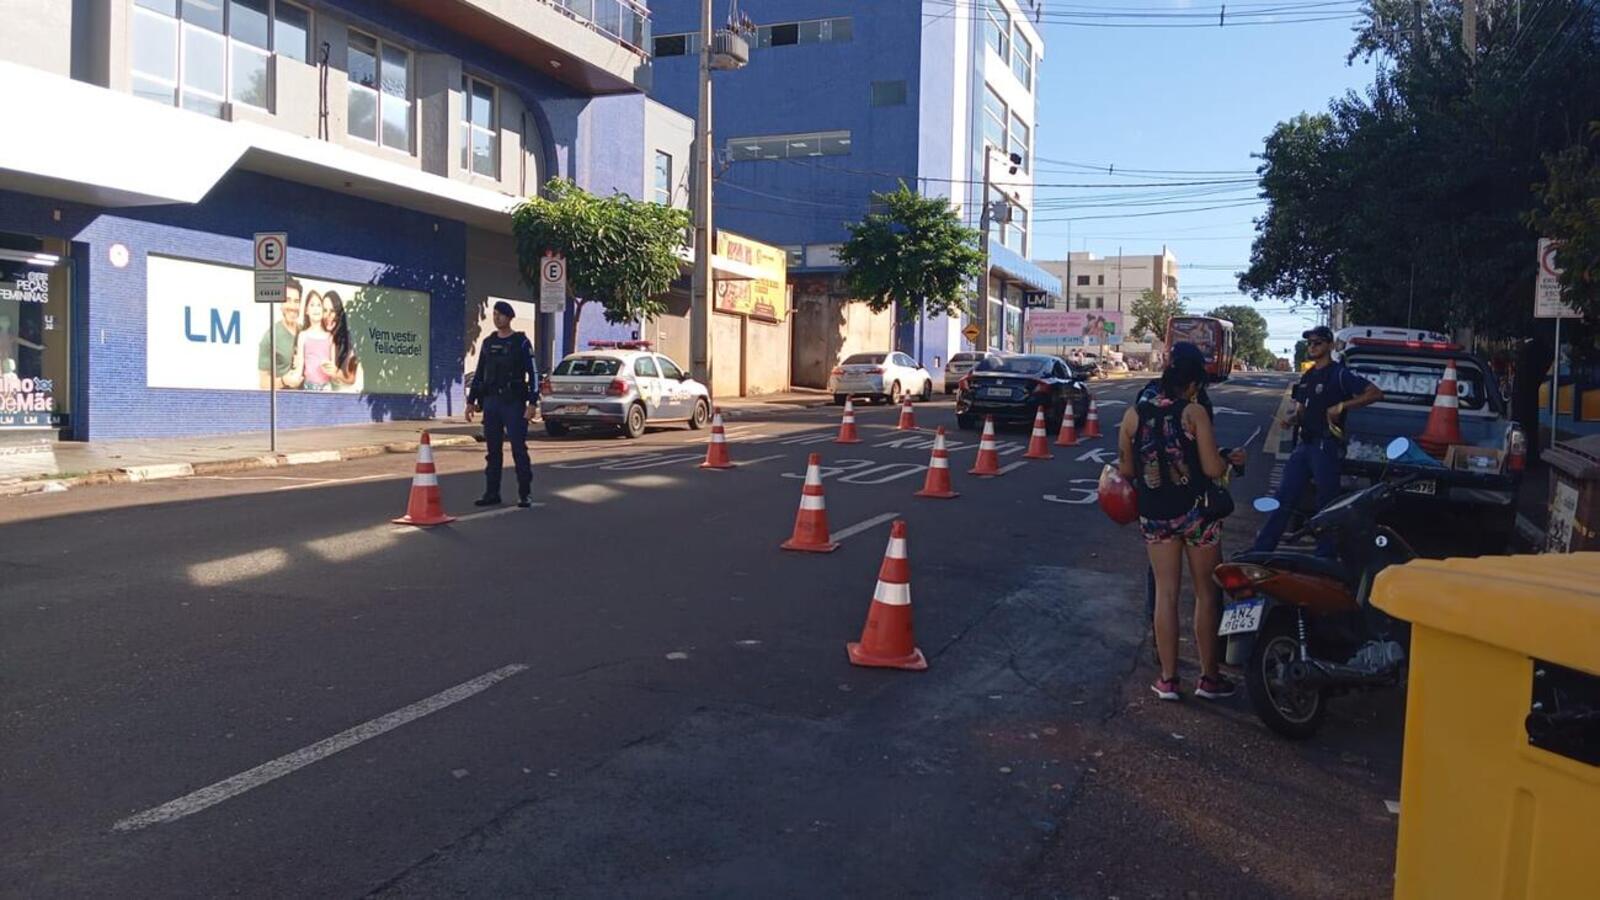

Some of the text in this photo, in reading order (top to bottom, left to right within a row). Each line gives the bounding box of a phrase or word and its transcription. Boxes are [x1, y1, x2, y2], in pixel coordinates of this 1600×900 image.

[265, 243, 275, 260] E
[549, 264, 558, 278] E
[1027, 295, 1046, 304] LM
[184, 305, 241, 344] LM
[368, 326, 416, 343] Vem vestir
[374, 341, 422, 356] felicidade!
[781, 459, 929, 484] 30
